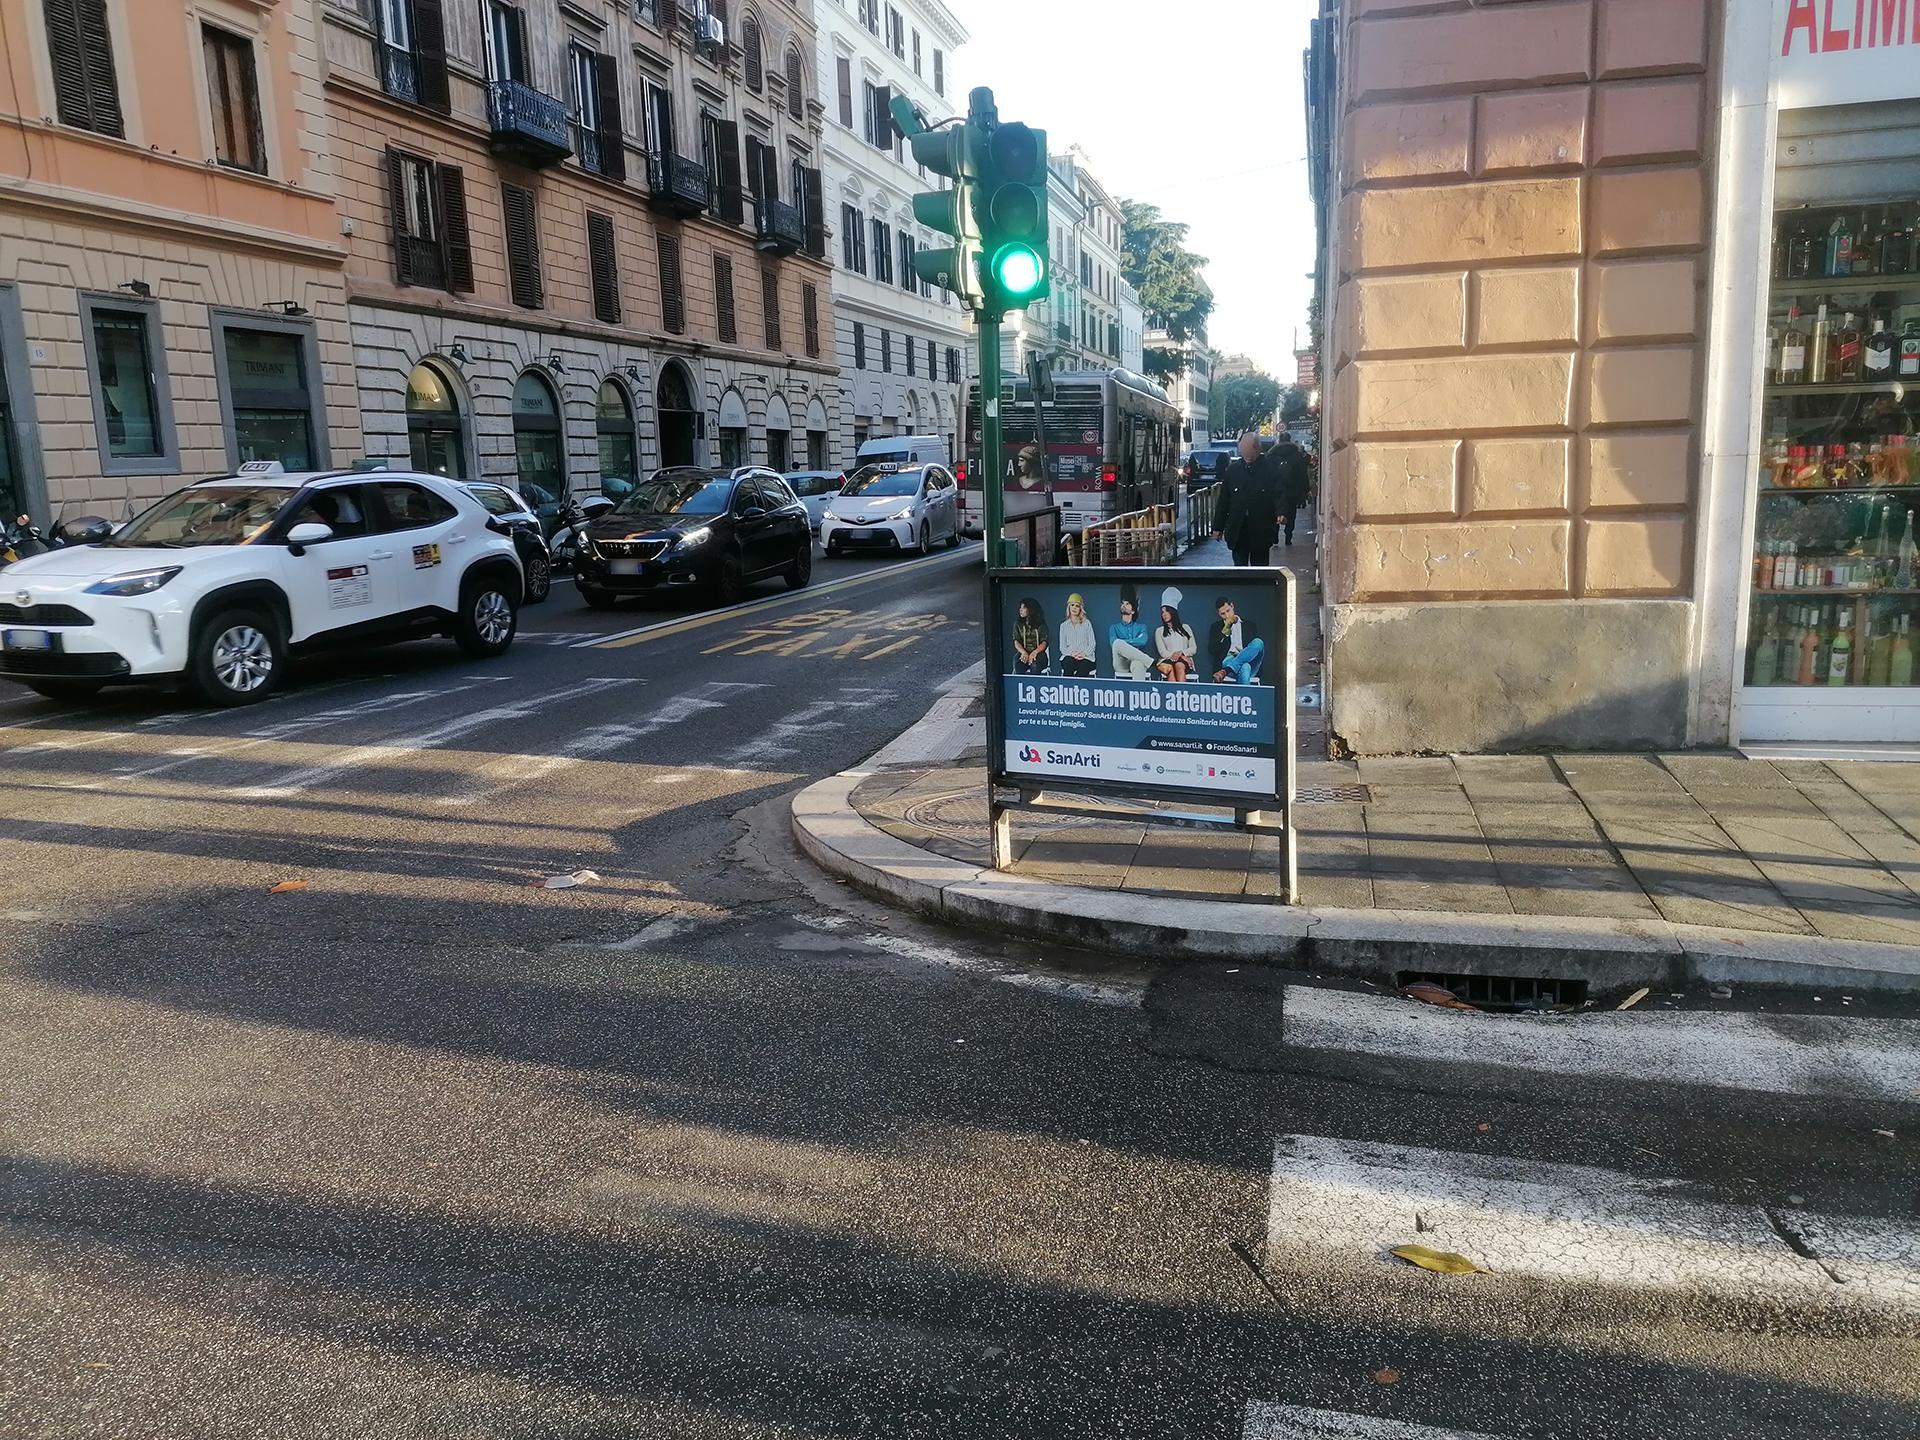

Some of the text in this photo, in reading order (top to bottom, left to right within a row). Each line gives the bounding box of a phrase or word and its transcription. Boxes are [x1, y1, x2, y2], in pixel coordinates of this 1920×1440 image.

[1781, 0, 1920, 57] ALIM
[245, 361, 285, 375] TRIMANI
[1094, 465, 1103, 490] ROMA
[699, 630, 924, 660] TAXI
[1018, 682, 1257, 716] La salute non può attendere.
[1018, 708, 1038, 716] Lavori
[1038, 708, 1088, 719] nell'artigianato?
[1088, 711, 1113, 720] SanArti
[1112, 712, 1117, 720] è
[1117, 712, 1122, 720] il
[1122, 713, 1143, 722] Fondo
[1150, 715, 1186, 724] Assistenza
[1186, 717, 1219, 726] Sanitaria
[1219, 719, 1258, 729] Integrativa
[1018, 718, 1030, 726] per
[1041, 718, 1048, 726] la
[1059, 719, 1087, 729] famiglia.
[1157, 740, 1258, 753] www.sanarti.it FondoSanarti
[1046, 750, 1101, 768] SanArti
